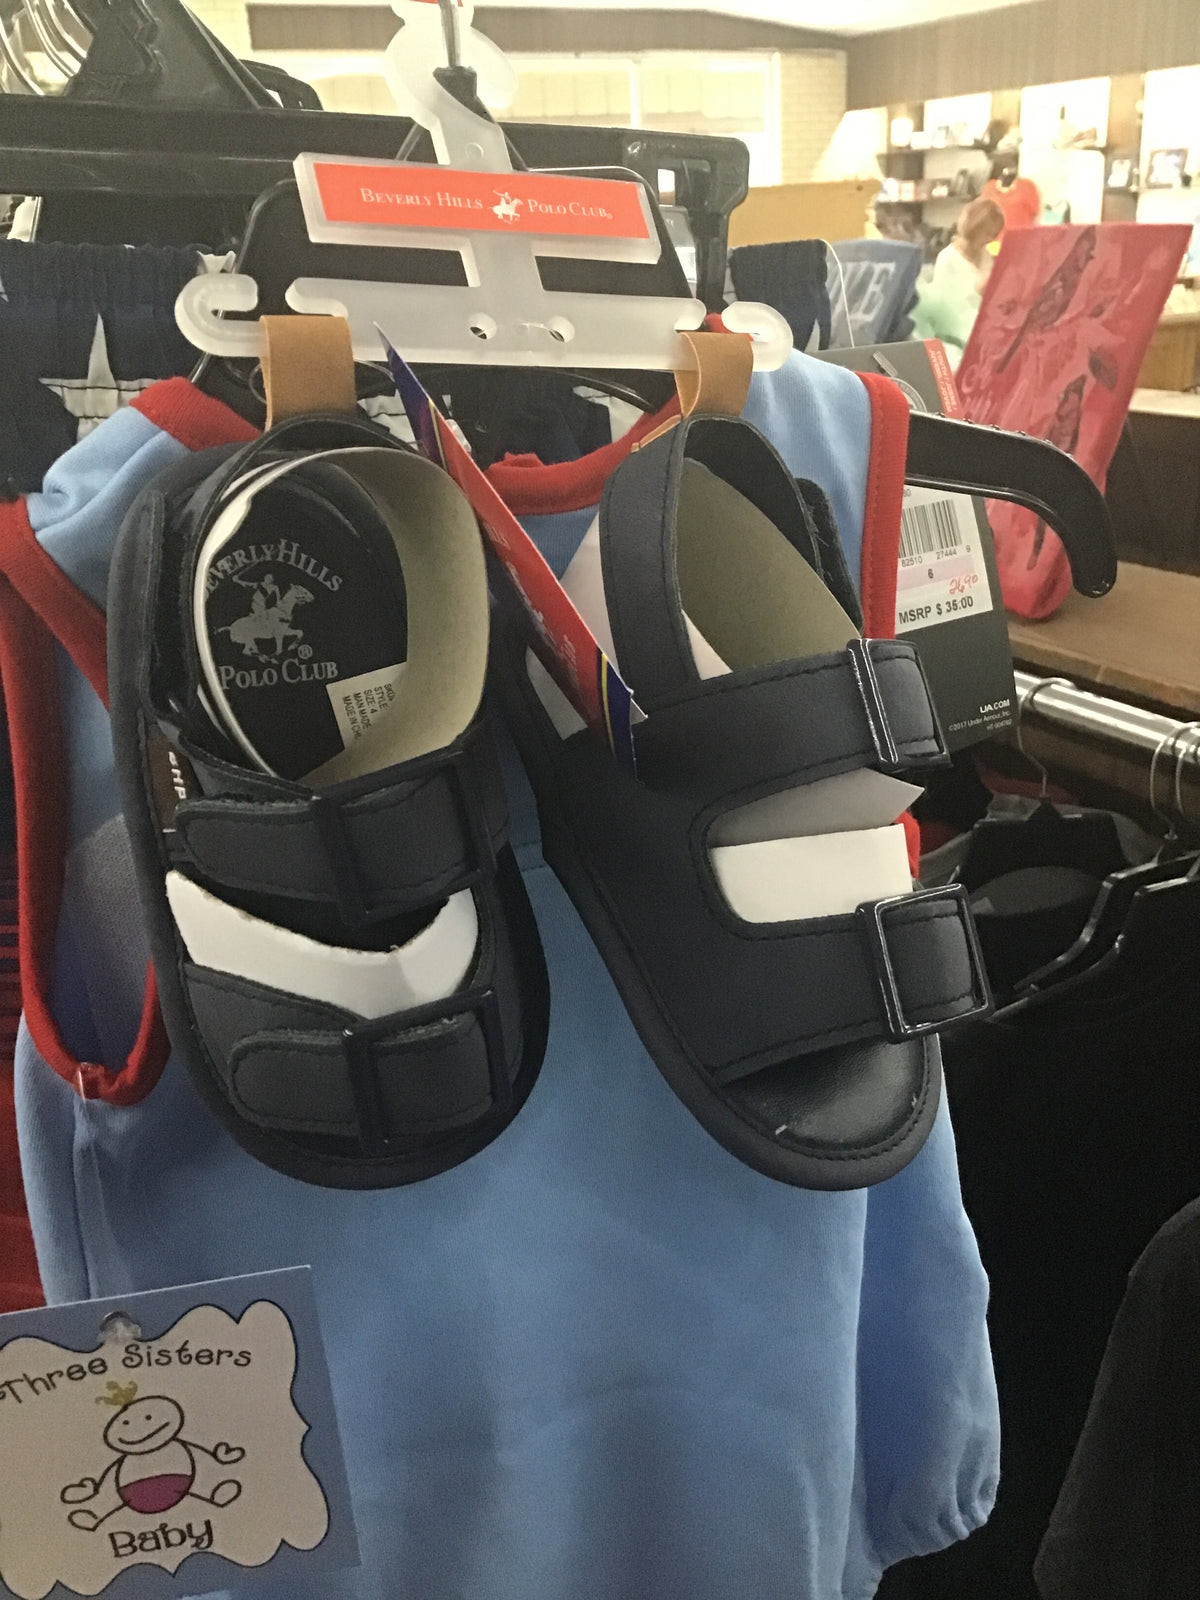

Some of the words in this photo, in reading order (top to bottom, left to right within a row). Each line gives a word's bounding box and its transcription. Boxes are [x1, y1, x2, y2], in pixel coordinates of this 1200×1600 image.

[360, 187, 432, 206] BEVERLY
[436, 191, 484, 210] HILLS
[527, 198, 567, 216] POLO
[204, 543, 274, 600] EVERLY
[277, 538, 343, 592] HILLS
[927, 568, 934, 579] 6
[898, 605, 932, 625] MSRP
[935, 602, 943, 616] $
[945, 595, 974, 614] 35.00
[219, 665, 278, 690] POLO
[282, 658, 339, 684] CLUB
[342, 695, 357, 718] MADE
[353, 692, 365, 710] MAN
[359, 709, 373, 730] MADE
[0, 1357, 108, 1404] Three
[122, 1339, 252, 1369] Sisters
[108, 1519, 215, 1558] Baby
